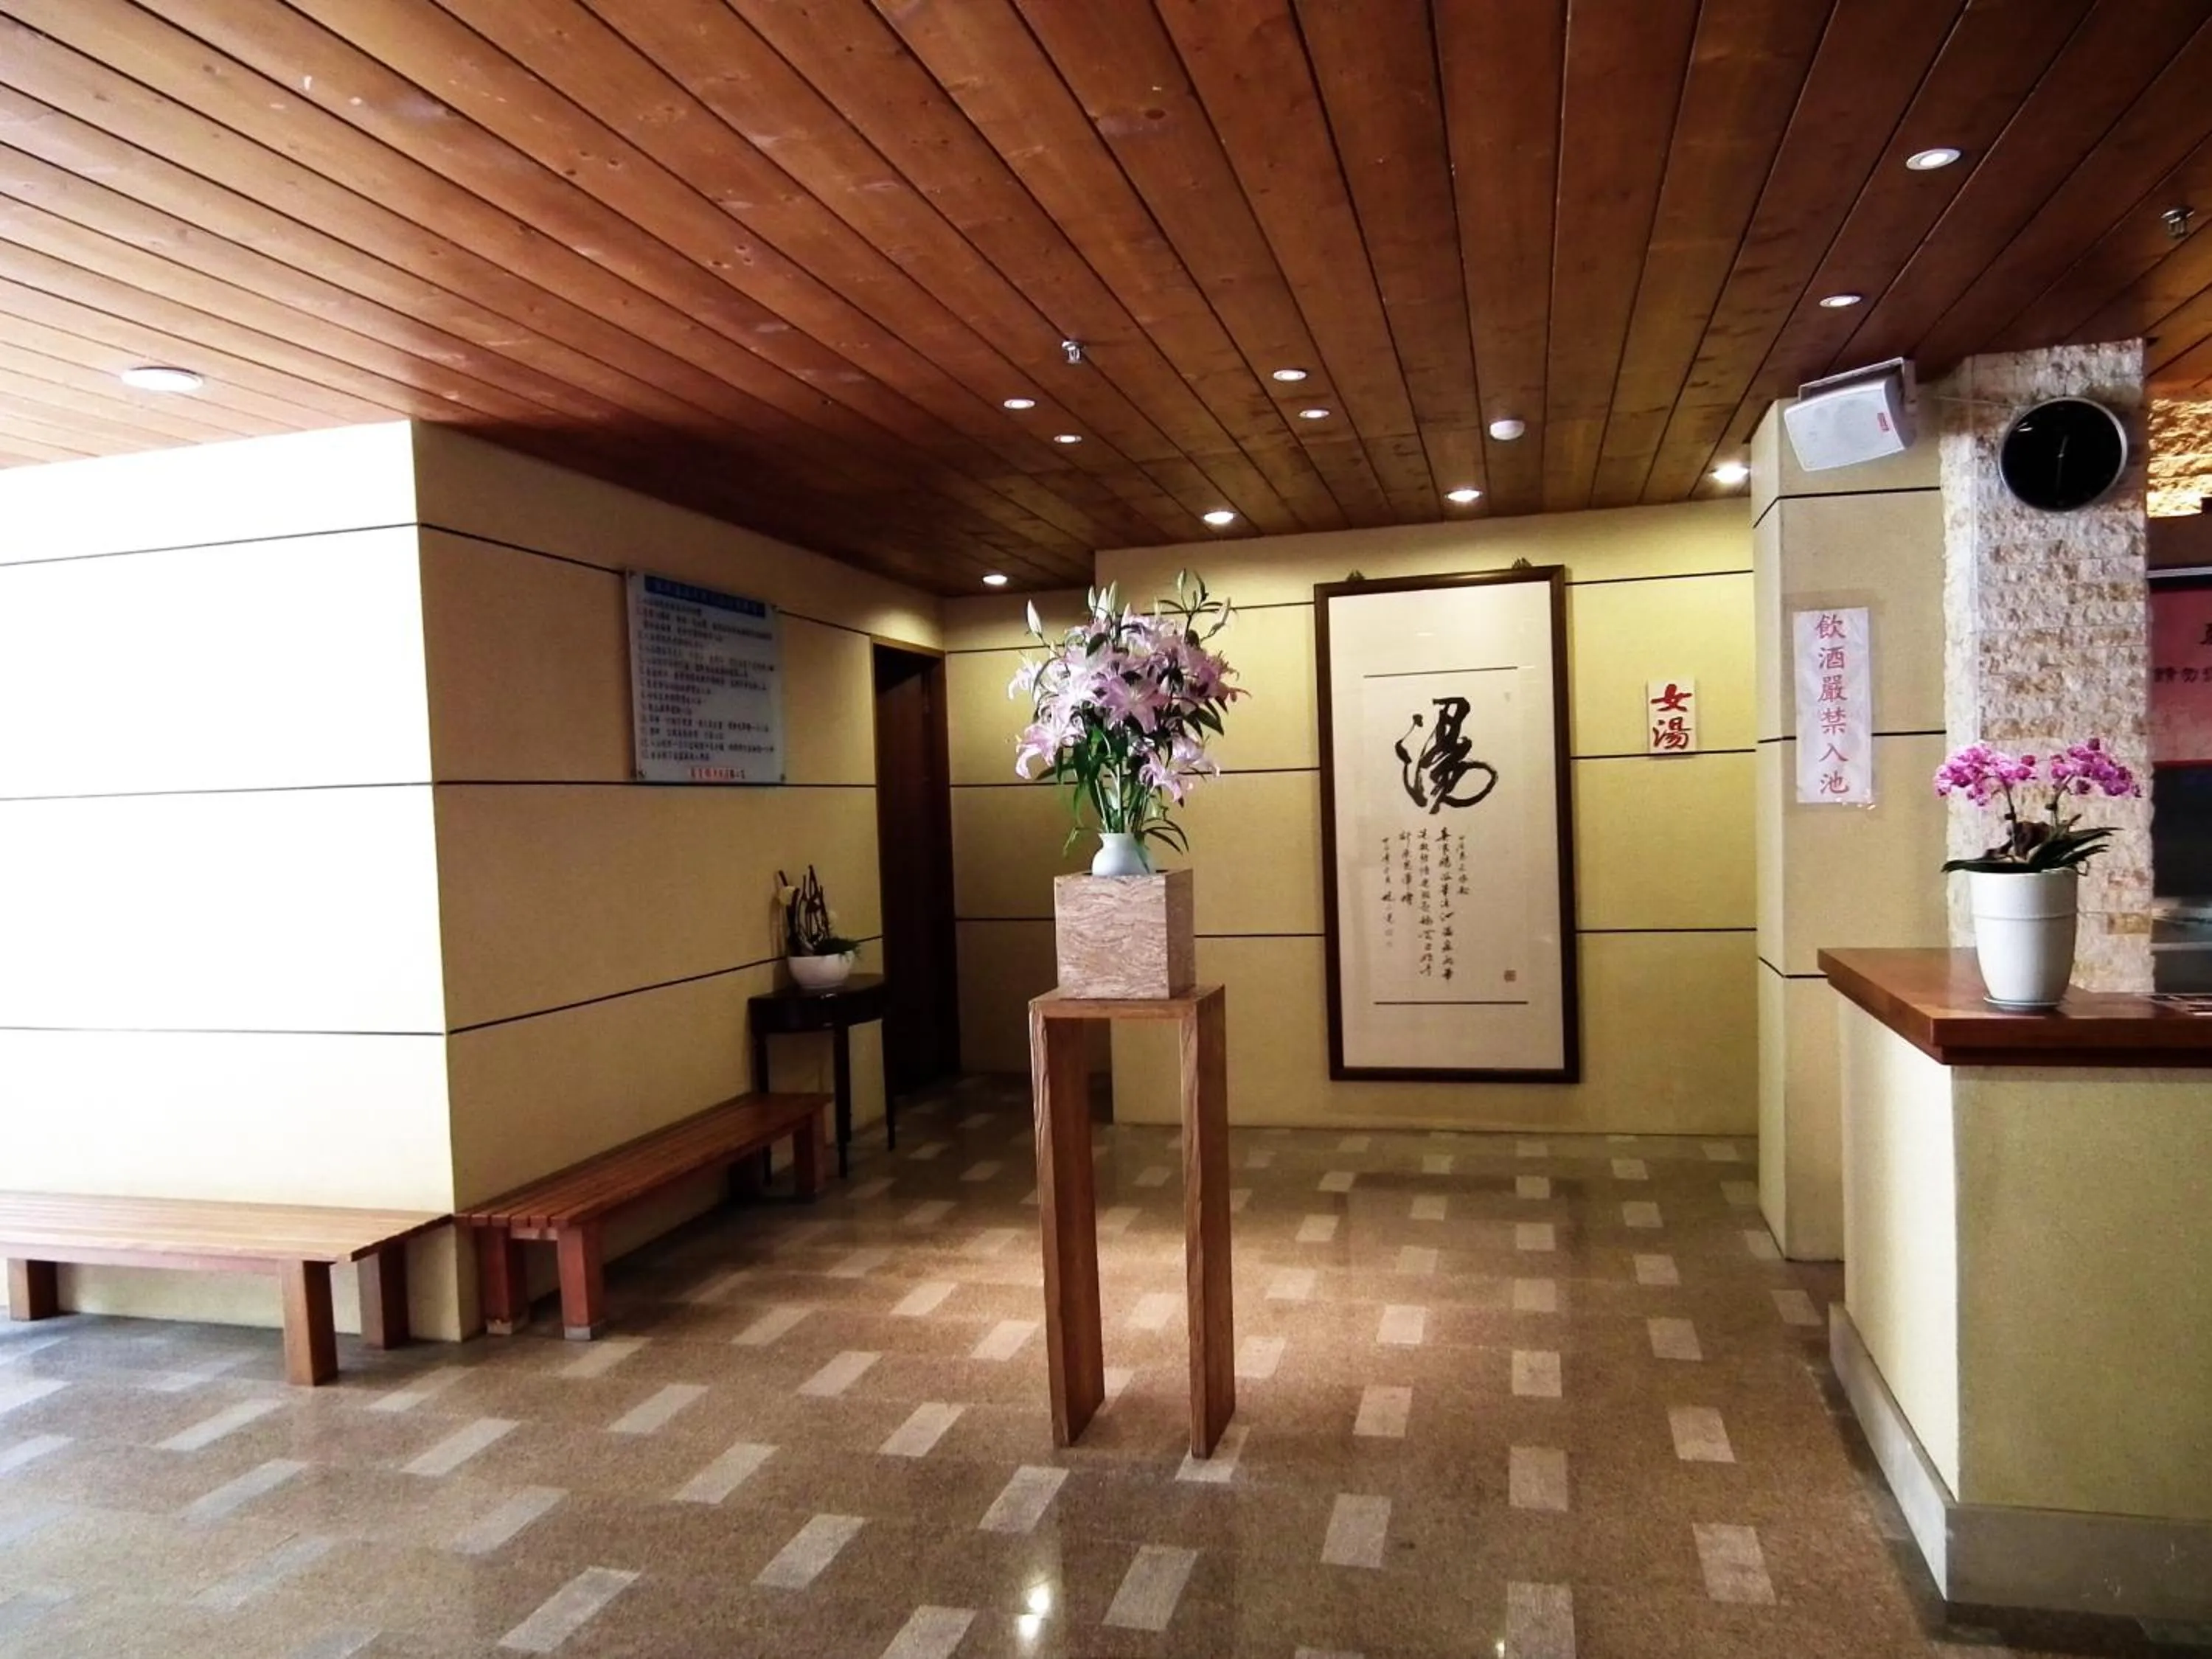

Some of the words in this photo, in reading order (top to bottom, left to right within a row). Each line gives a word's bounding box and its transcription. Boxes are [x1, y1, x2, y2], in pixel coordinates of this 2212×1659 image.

[1650, 684, 1692, 750] 女湯
[1815, 613, 1850, 795] 飲酒嚴禁入池
